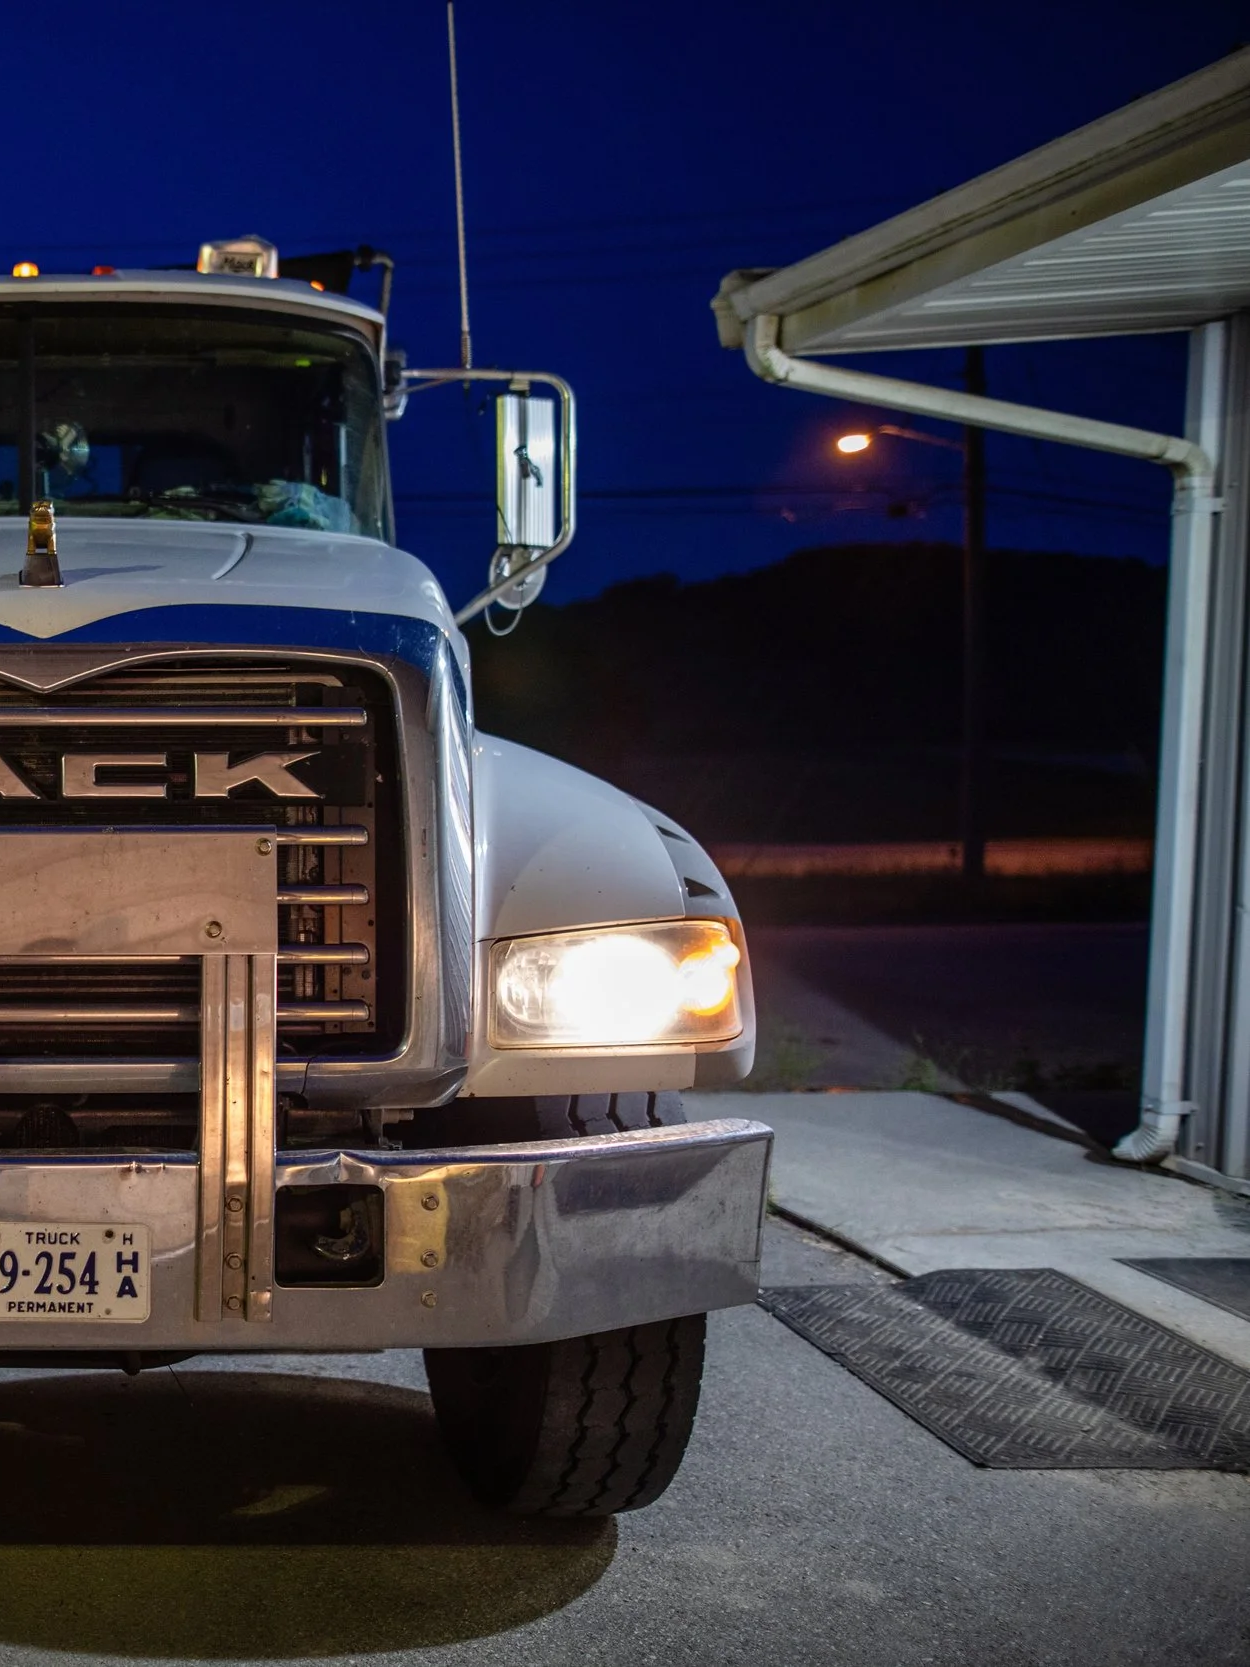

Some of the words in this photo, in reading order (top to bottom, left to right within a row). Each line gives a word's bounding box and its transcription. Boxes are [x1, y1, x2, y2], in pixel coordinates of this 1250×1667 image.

[25, 1232, 81, 1246] TRUCK
[122, 1233, 134, 1245] H
[7, 1301, 94, 1314] PERMANENT
